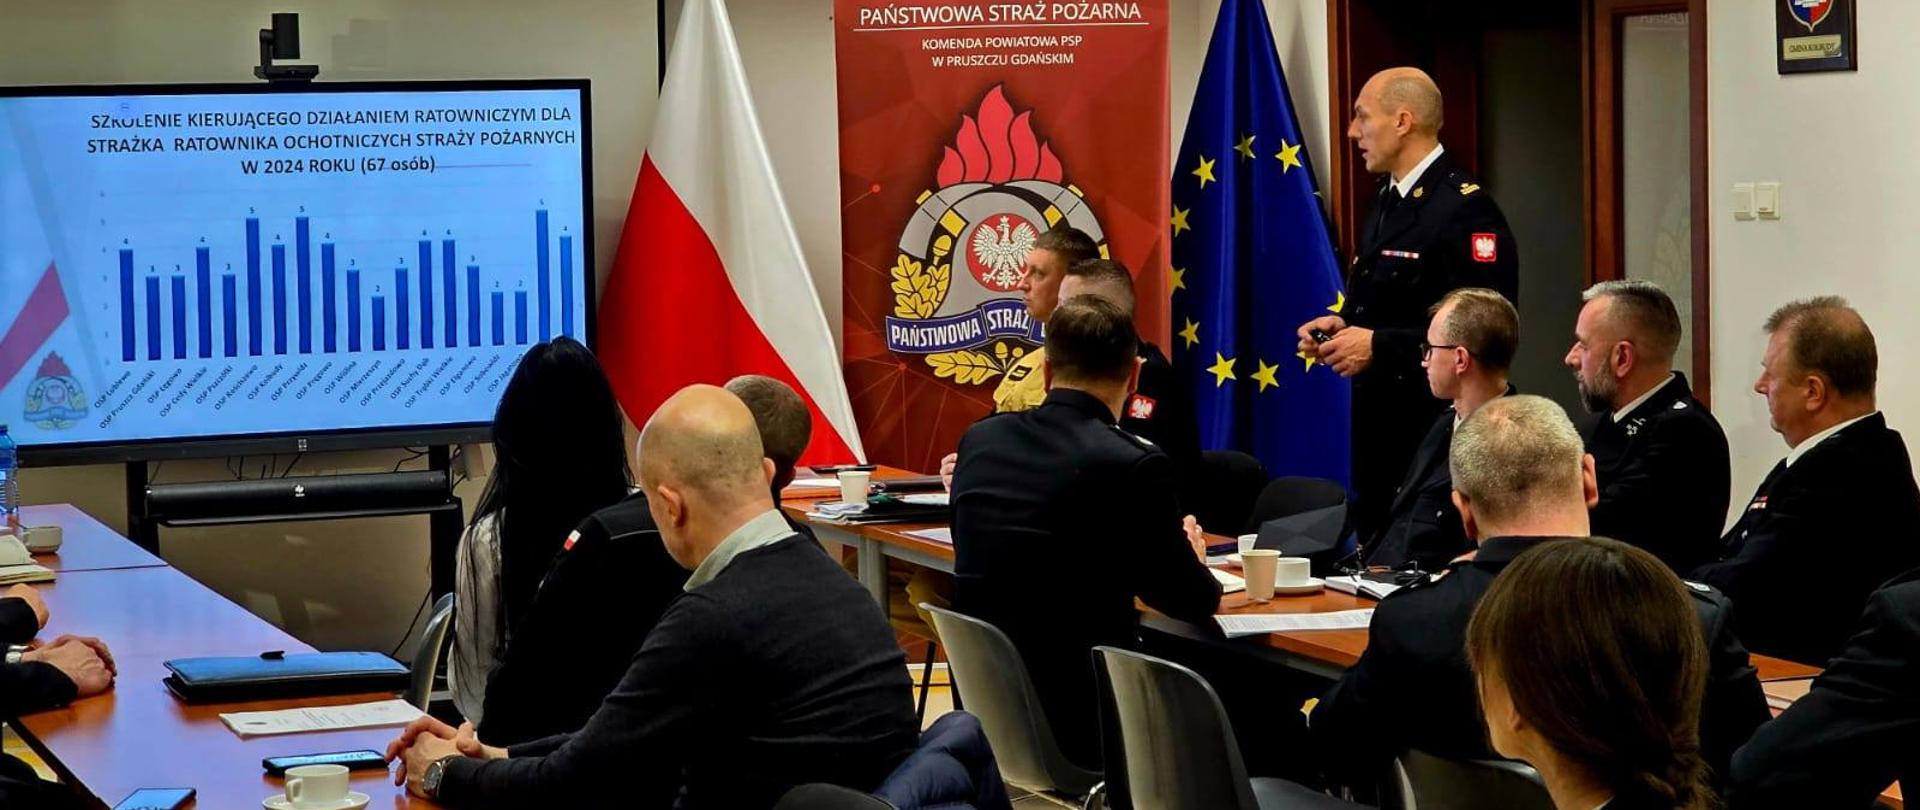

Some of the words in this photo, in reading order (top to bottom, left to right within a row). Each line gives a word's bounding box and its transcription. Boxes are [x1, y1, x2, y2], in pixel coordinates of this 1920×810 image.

[860, 5, 984, 26] PAŃSTWOWA
[988, 2, 1046, 22] STRAŻ
[1052, 1, 1142, 20] POŻARNA
[922, 38, 982, 50] KOMENDA
[985, 36, 1060, 48] POWIATOWA
[1061, 36, 1083, 47] PSP
[932, 56, 944, 67] W
[947, 54, 1008, 66] PRUSZCZU
[1010, 52, 1074, 65] GDAŃSKIM
[91, 113, 182, 129] SZKOLENIE
[188, 111, 302, 130] KIERUJĄCEGO
[307, 110, 409, 126] DZIAŁANIEM
[415, 108, 536, 124] RATOWNICZYM
[541, 107, 572, 122] DLA
[88, 135, 164, 153] STRAŻKA
[174, 136, 278, 152] RATOWNIKA
[284, 134, 412, 150] OCHOTNICZYCH
[416, 130, 475, 146] STRAŻY
[480, 128, 576, 146] POŻARNYCH
[242, 160, 258, 174] W
[264, 160, 304, 174] 2024
[310, 158, 356, 172] ROKU
[361, 157, 386, 175] (67
[391, 156, 436, 174] osób)
[891, 318, 982, 347] PAŃSTWOWA
[986, 308, 1029, 330] STRAŻ
[248, 385, 260, 400] OSP
[296, 385, 308, 400] OSP
[324, 380, 336, 394] OSP
[440, 382, 453, 396] OSP
[464, 380, 476, 394] OSP
[488, 378, 500, 393] OSP
[196, 390, 208, 404] OSP
[271, 386, 284, 400] OSP
[339, 390, 352, 404] OSP
[360, 392, 374, 406] OSP
[390, 386, 403, 400] OSP
[214, 395, 228, 410] OSP
[404, 394, 418, 408] OSP
